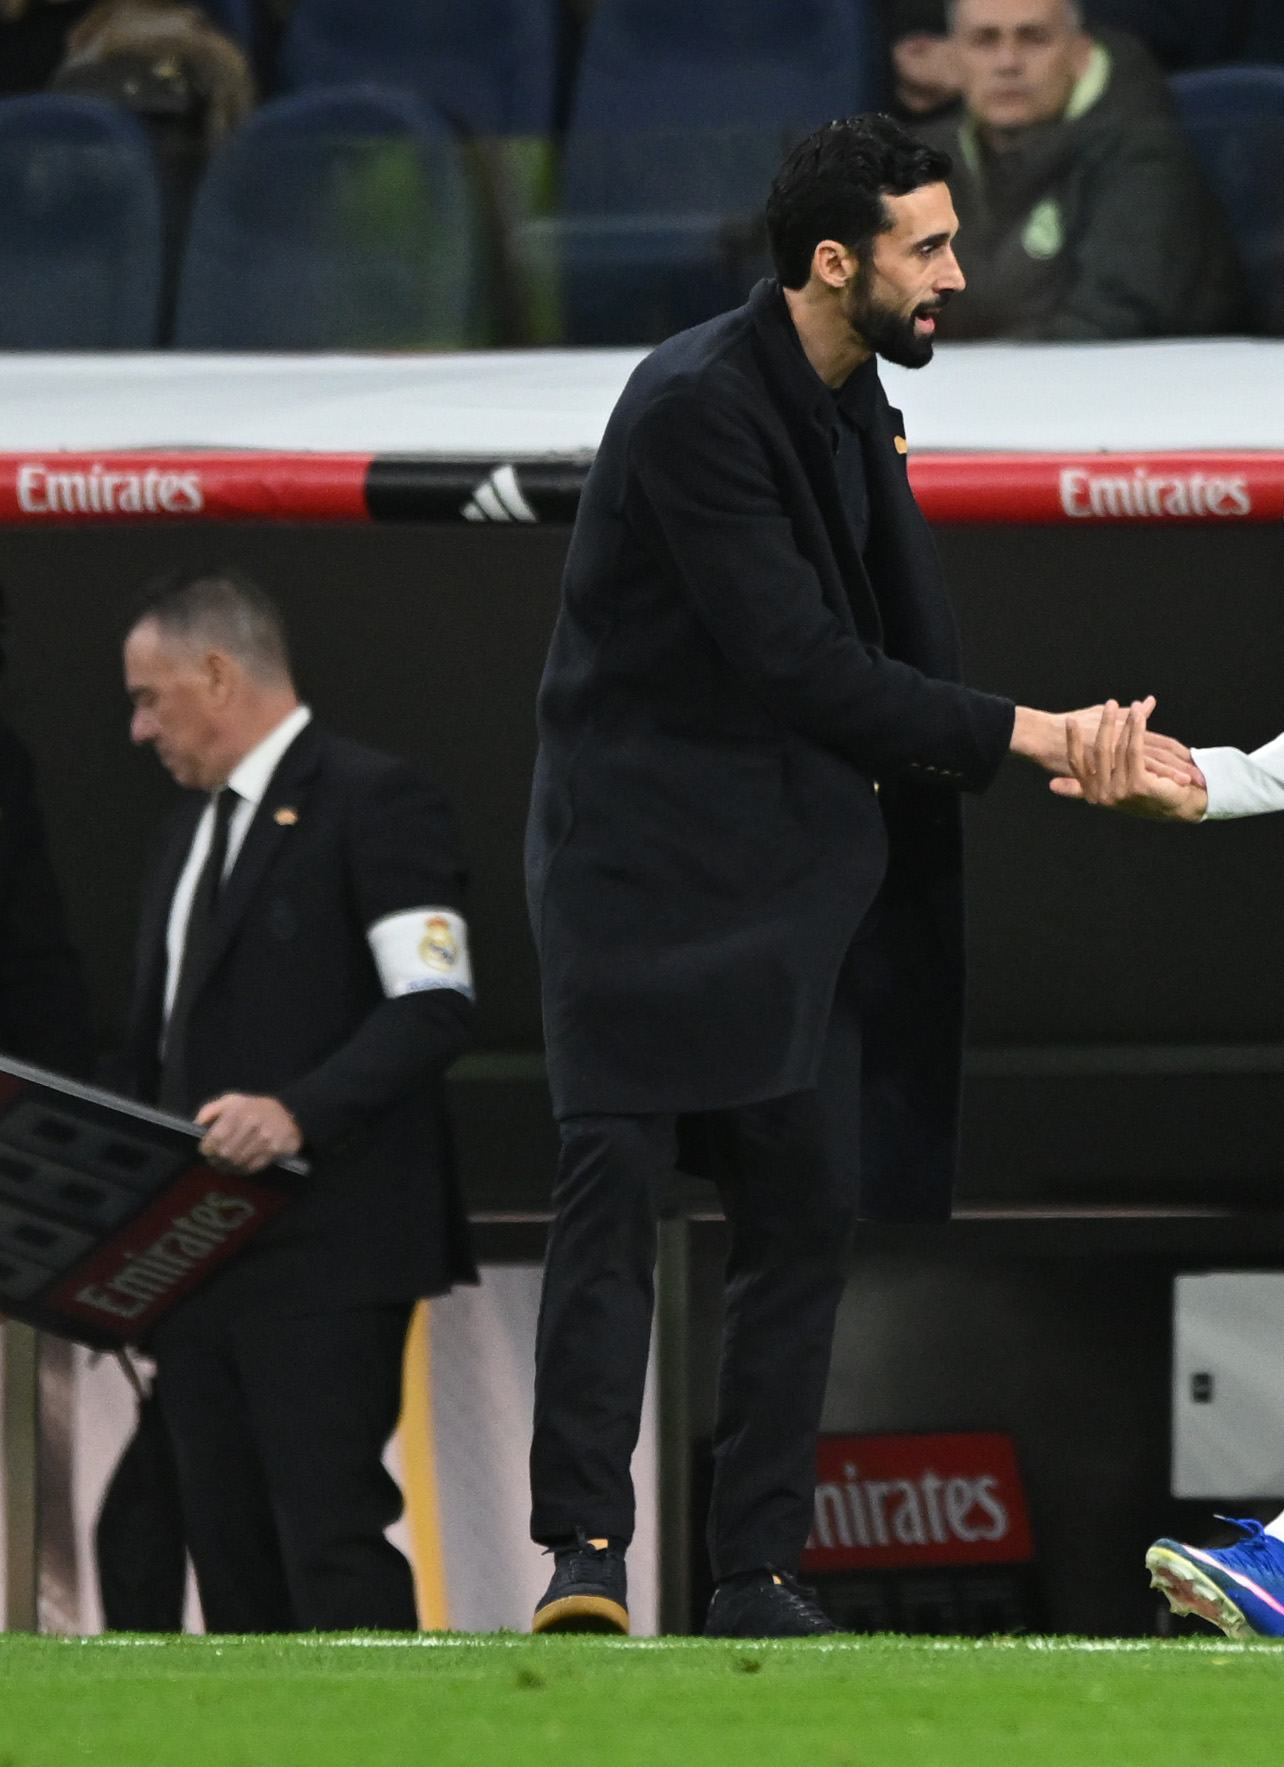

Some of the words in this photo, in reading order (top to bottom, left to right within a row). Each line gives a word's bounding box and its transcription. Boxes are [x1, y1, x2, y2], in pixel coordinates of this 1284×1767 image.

[18, 465, 203, 512] Emirates
[1060, 468, 1250, 517] Emirates
[75, 1191, 255, 1319] Emirates
[804, 1462, 1009, 1548] mirates
